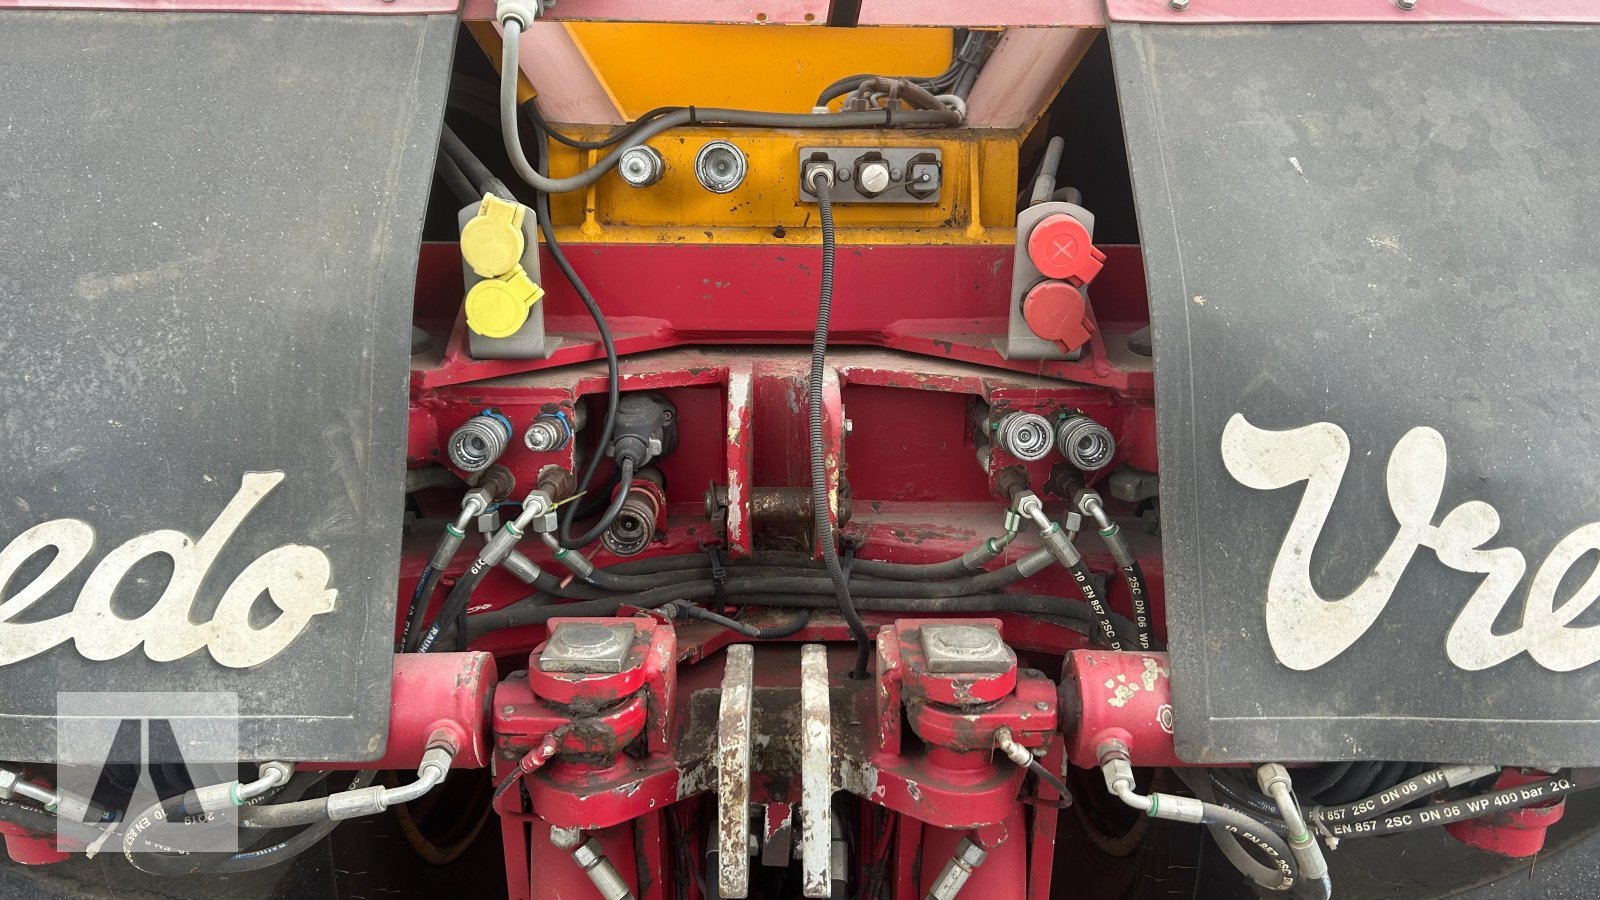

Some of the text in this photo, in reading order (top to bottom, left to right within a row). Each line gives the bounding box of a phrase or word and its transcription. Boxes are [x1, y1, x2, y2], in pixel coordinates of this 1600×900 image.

[1128, 576, 1141, 595] 2SC
[1074, 571, 1086, 582] 10
[1082, 584, 1096, 599] EN
[1090, 599, 1105, 615] 857
[1100, 619, 1116, 638] 2SC
[1134, 600, 1146, 614] DN
[1137, 616, 1147, 628] 06
[1139, 633, 1149, 649] WP
[1327, 808, 1346, 821] 857
[1352, 799, 1376, 816] 2SC
[1380, 788, 1402, 805] DN
[1402, 781, 1418, 795] 06
[1334, 823, 1352, 835] EN
[1354, 820, 1377, 832] 857
[1385, 814, 1413, 828] 2SC
[1419, 810, 1441, 823] DN
[1443, 805, 1461, 818] 06
[1466, 798, 1490, 813] WP
[1494, 791, 1519, 807] 400
[1520, 785, 1543, 800] bar
[135, 816, 151, 832] EN
[125, 828, 138, 846] 857
